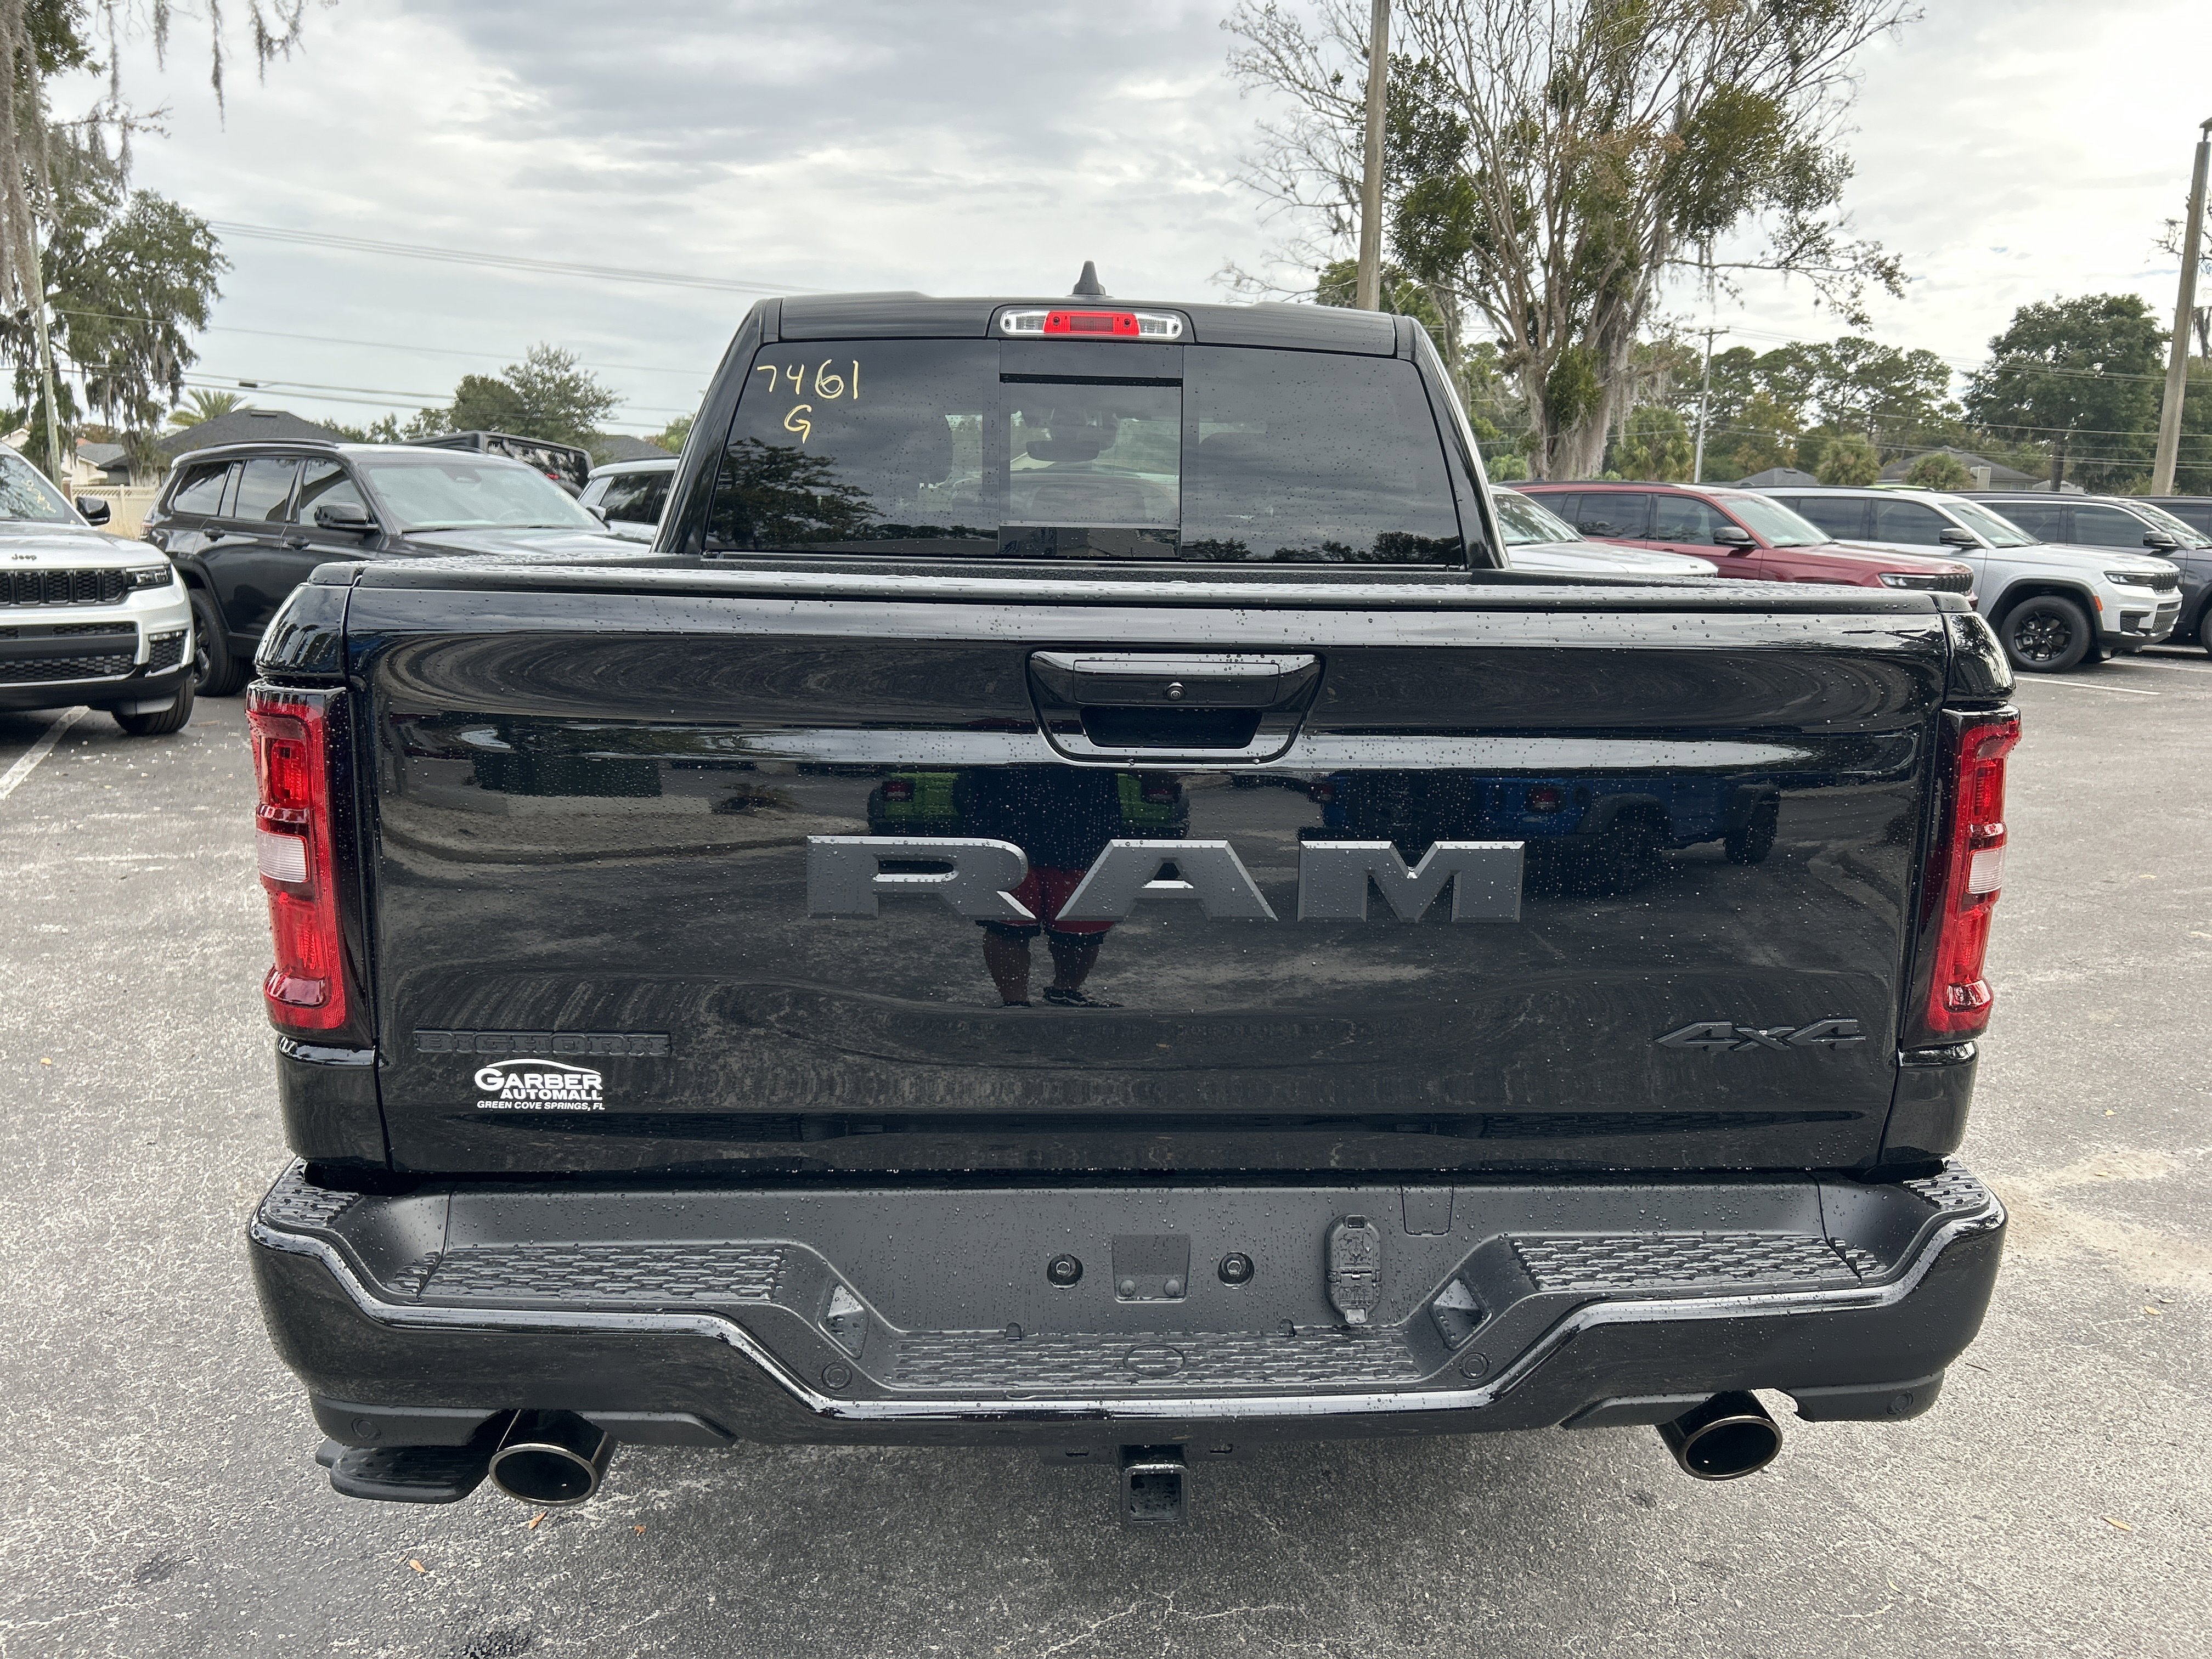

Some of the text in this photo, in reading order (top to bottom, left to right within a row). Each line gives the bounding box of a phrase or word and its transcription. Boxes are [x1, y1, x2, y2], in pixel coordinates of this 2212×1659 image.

[757, 359, 859, 400] 7461
[11, 553, 37, 561] Jeep
[806, 834, 1526, 924] RAM
[475, 1068, 603, 1091] GARBER
[500, 1088, 603, 1101] AUTOMALL
[477, 1100, 512, 1109] GREEN
[514, 1101, 542, 1109] COVE
[544, 1102, 591, 1111] SPRINGS,
